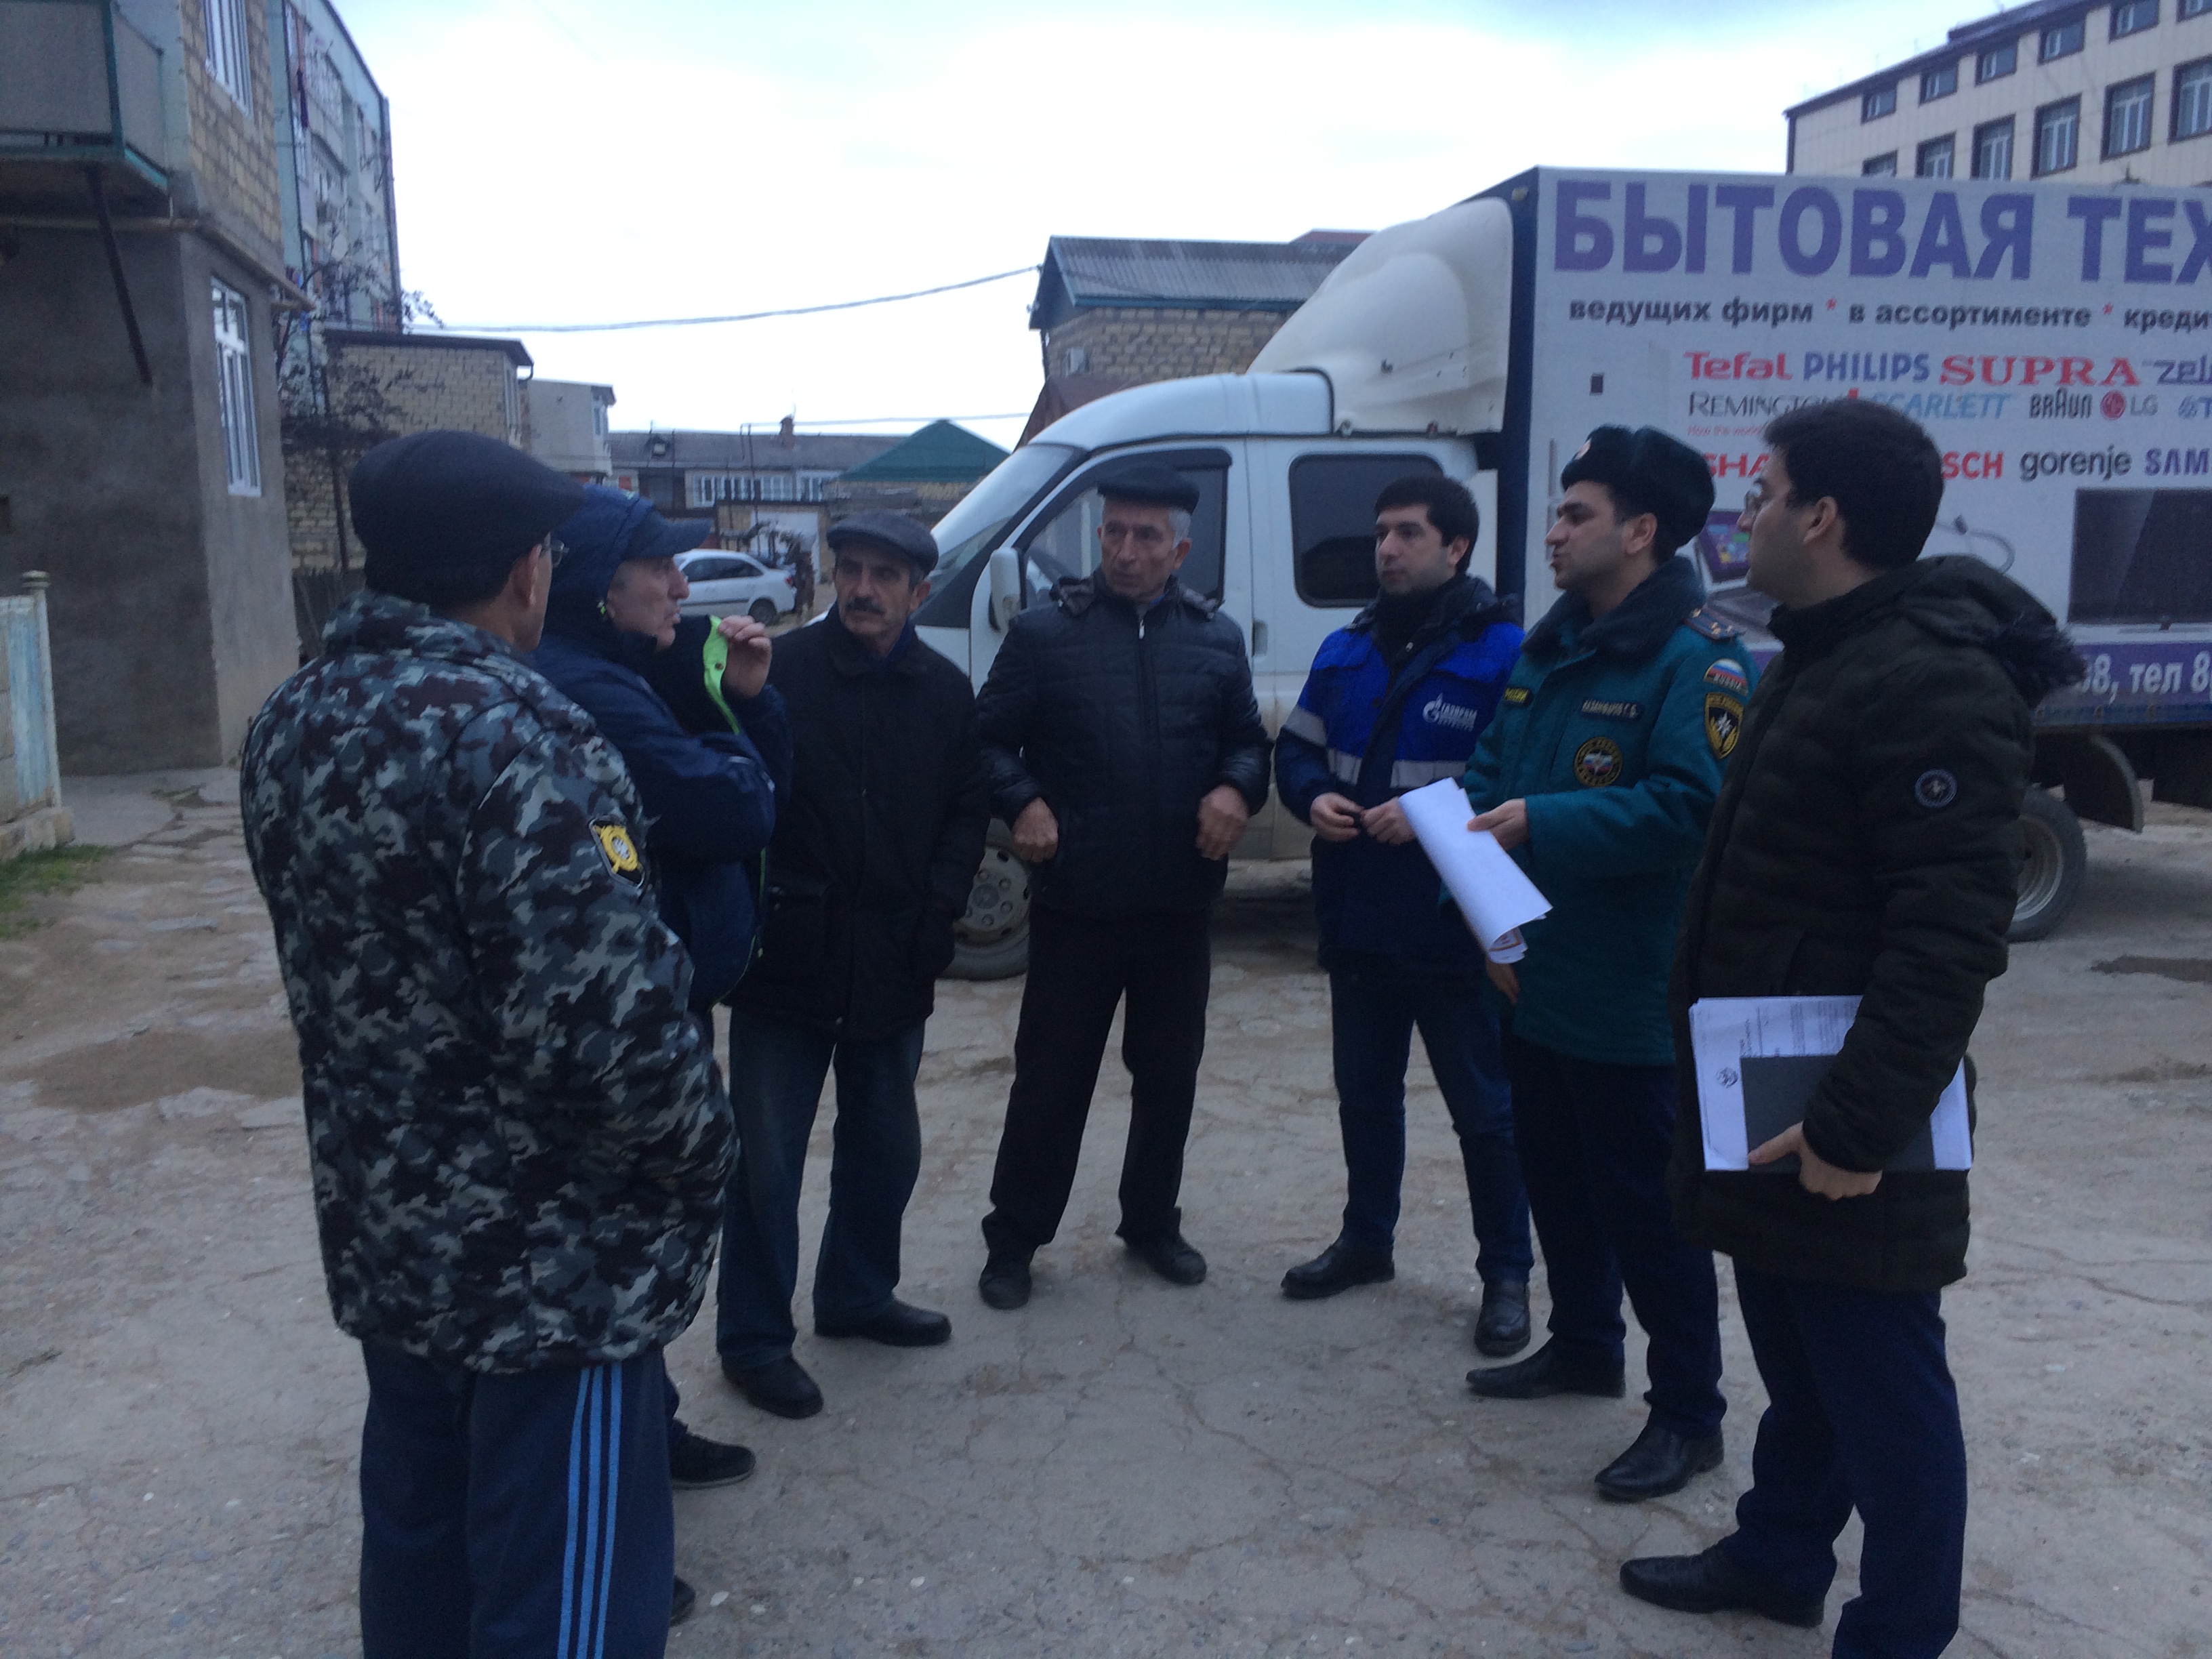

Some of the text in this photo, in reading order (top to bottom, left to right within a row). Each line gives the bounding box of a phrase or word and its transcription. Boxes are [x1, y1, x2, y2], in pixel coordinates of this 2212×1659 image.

[1555, 180, 2212, 285] БЫТОВАЯ ТЕХ
[1569, 296, 2212, 335] ведущих фирм в ассортименте креди
[1683, 351, 2212, 386] Tefal PHILIPS SUPRA zel
[1688, 390, 1826, 417] REMINGT
[2029, 387, 2093, 419] BRAUN
[2020, 444, 2133, 482] gorenje
[2129, 661, 2184, 695] тел
[2190, 650, 2212, 695] 8
